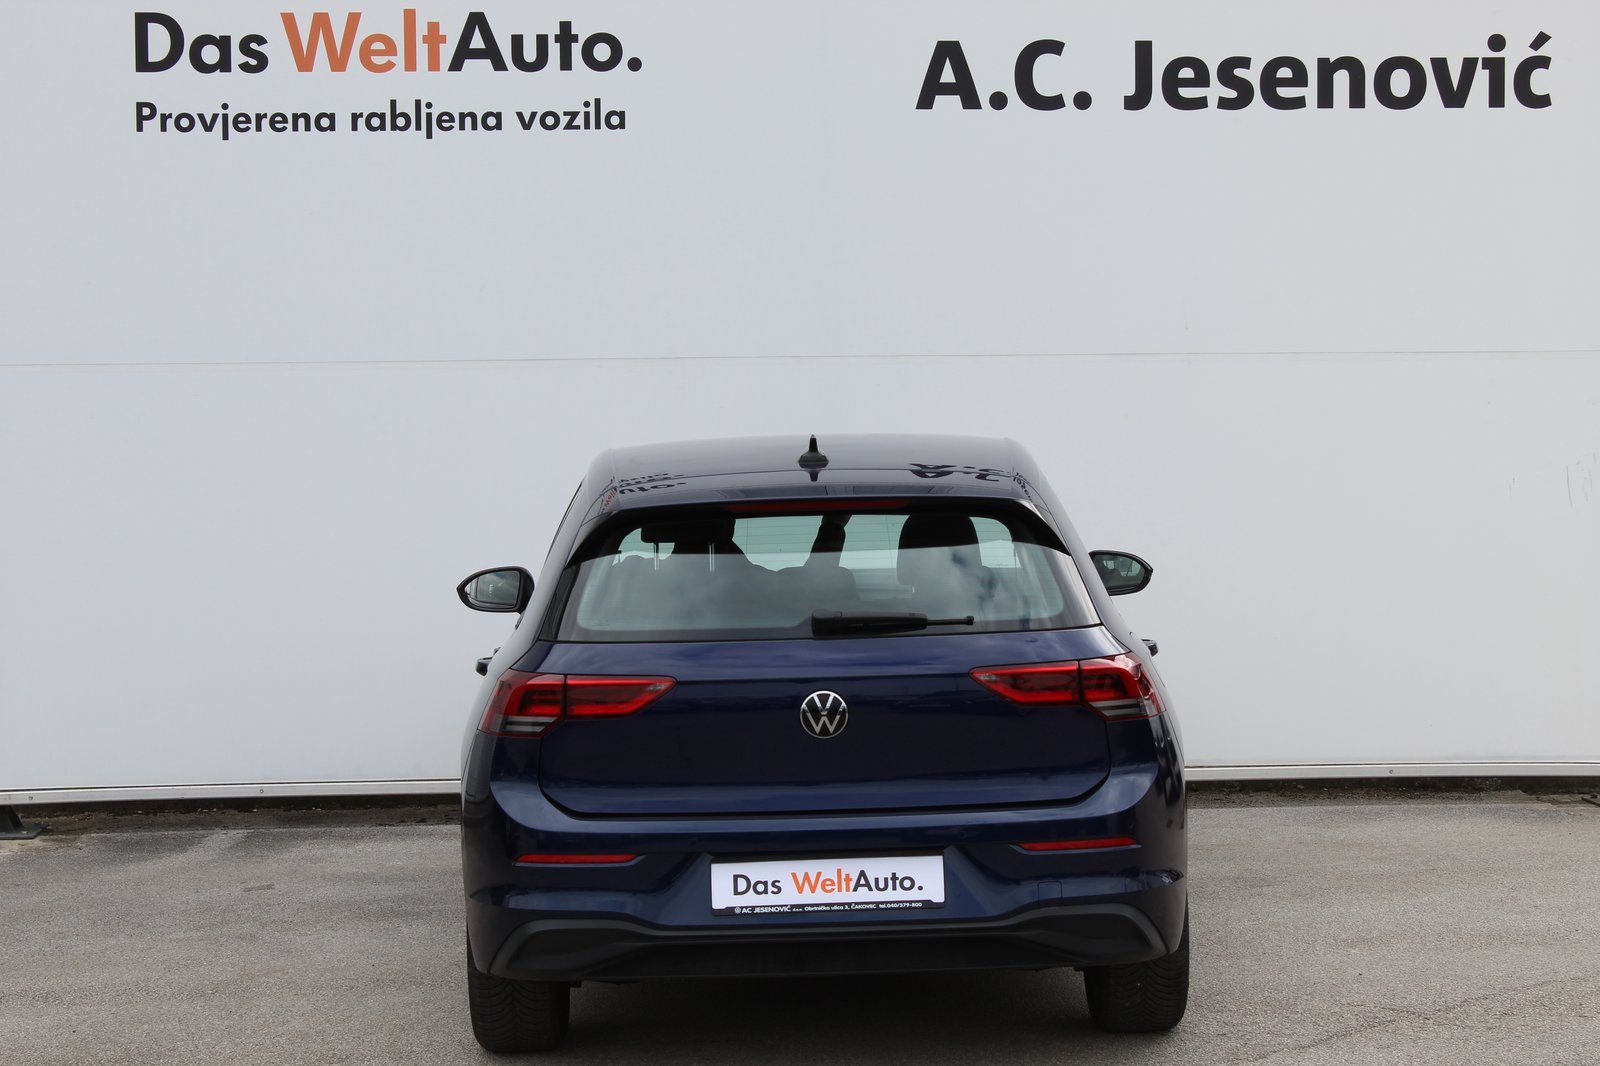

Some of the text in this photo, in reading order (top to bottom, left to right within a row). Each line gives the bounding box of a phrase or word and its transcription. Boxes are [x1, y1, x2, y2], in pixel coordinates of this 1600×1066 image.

[135, 9, 642, 74] Das WeltAuto.
[916, 31, 1552, 111] A.C. Jesenović
[136, 98, 626, 140] Provjerena rabljena vozila
[733, 868, 924, 895] Das WeltAuto.
[753, 904, 791, 914] JESENOVIĆ
